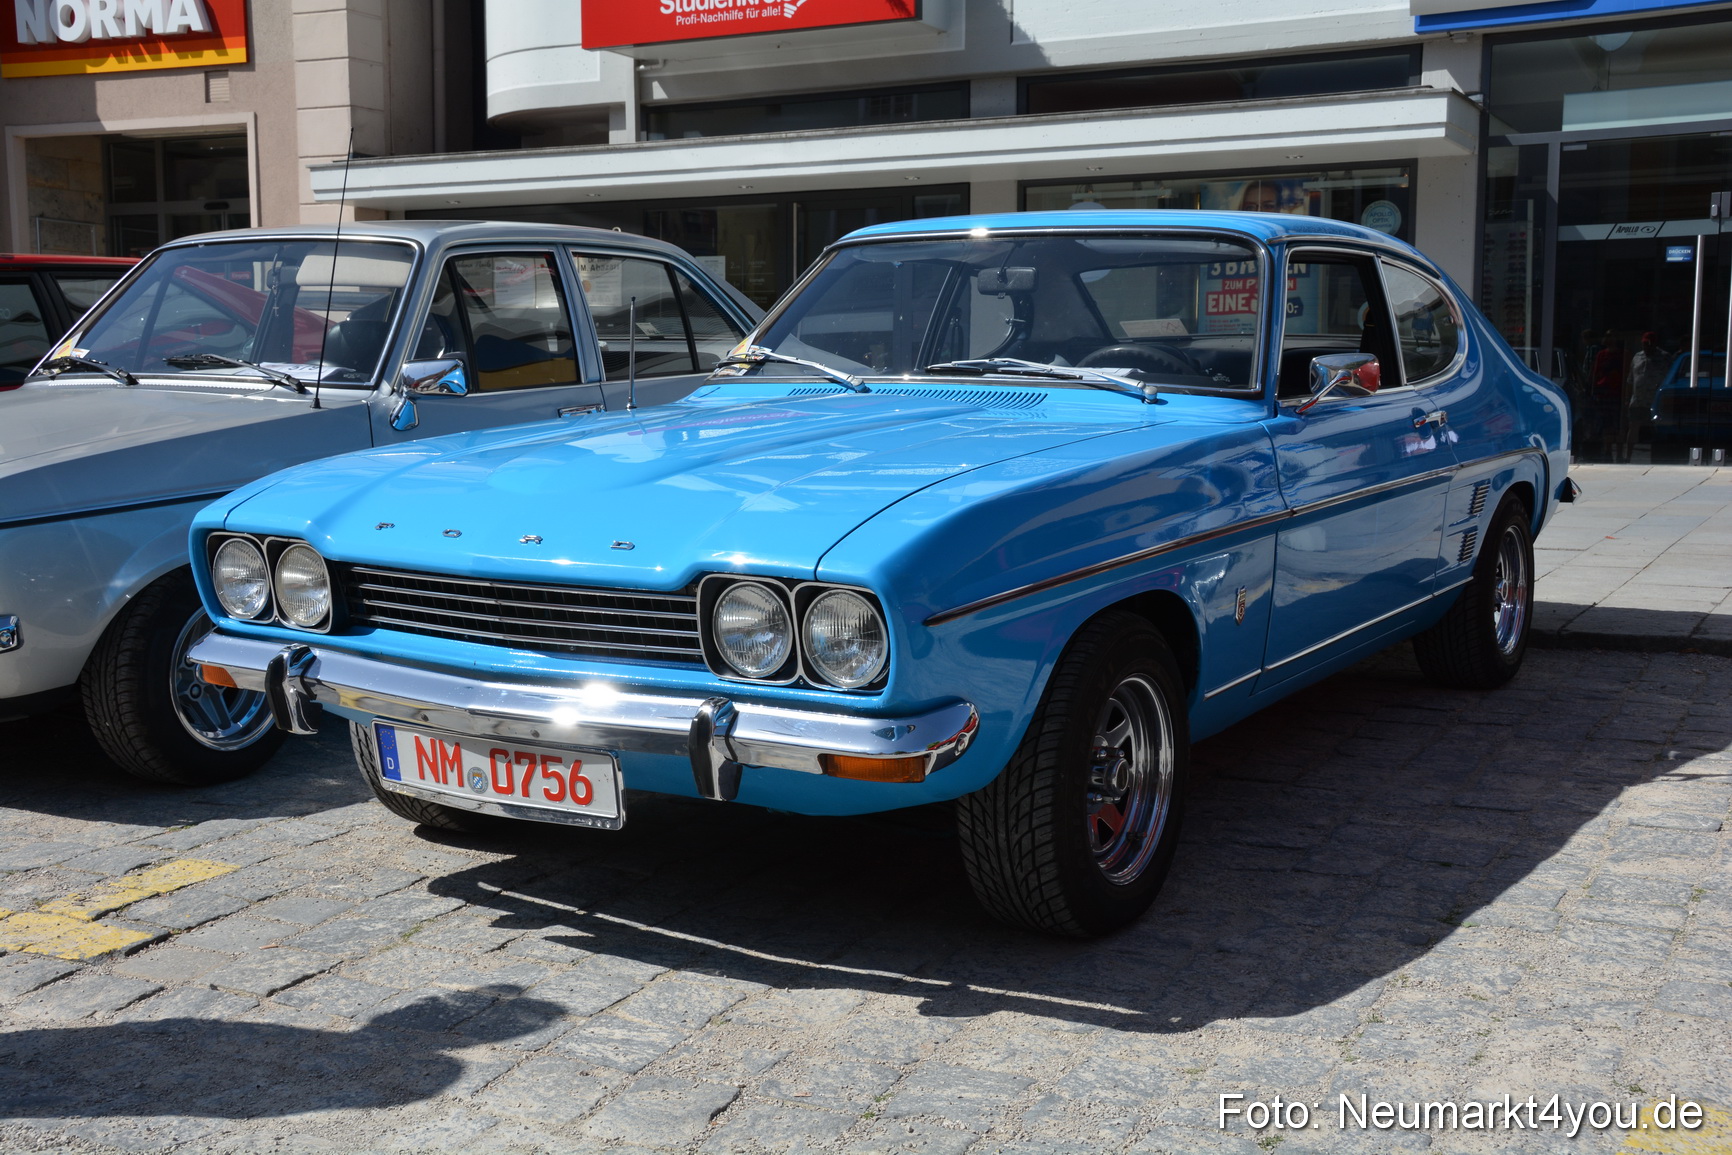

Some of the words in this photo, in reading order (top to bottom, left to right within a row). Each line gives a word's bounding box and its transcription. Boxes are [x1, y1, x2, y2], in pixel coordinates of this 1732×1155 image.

[15, 0, 210, 44] NORMA
[676, 10, 743, 26] Profi-Nachhilfe
[746, 8, 760, 19] für
[762, 6, 781, 17] alle!
[1225, 280, 1243, 290] ZUM
[386, 757, 395, 770] D
[413, 734, 464, 788] NM
[489, 747, 594, 806] 0756
